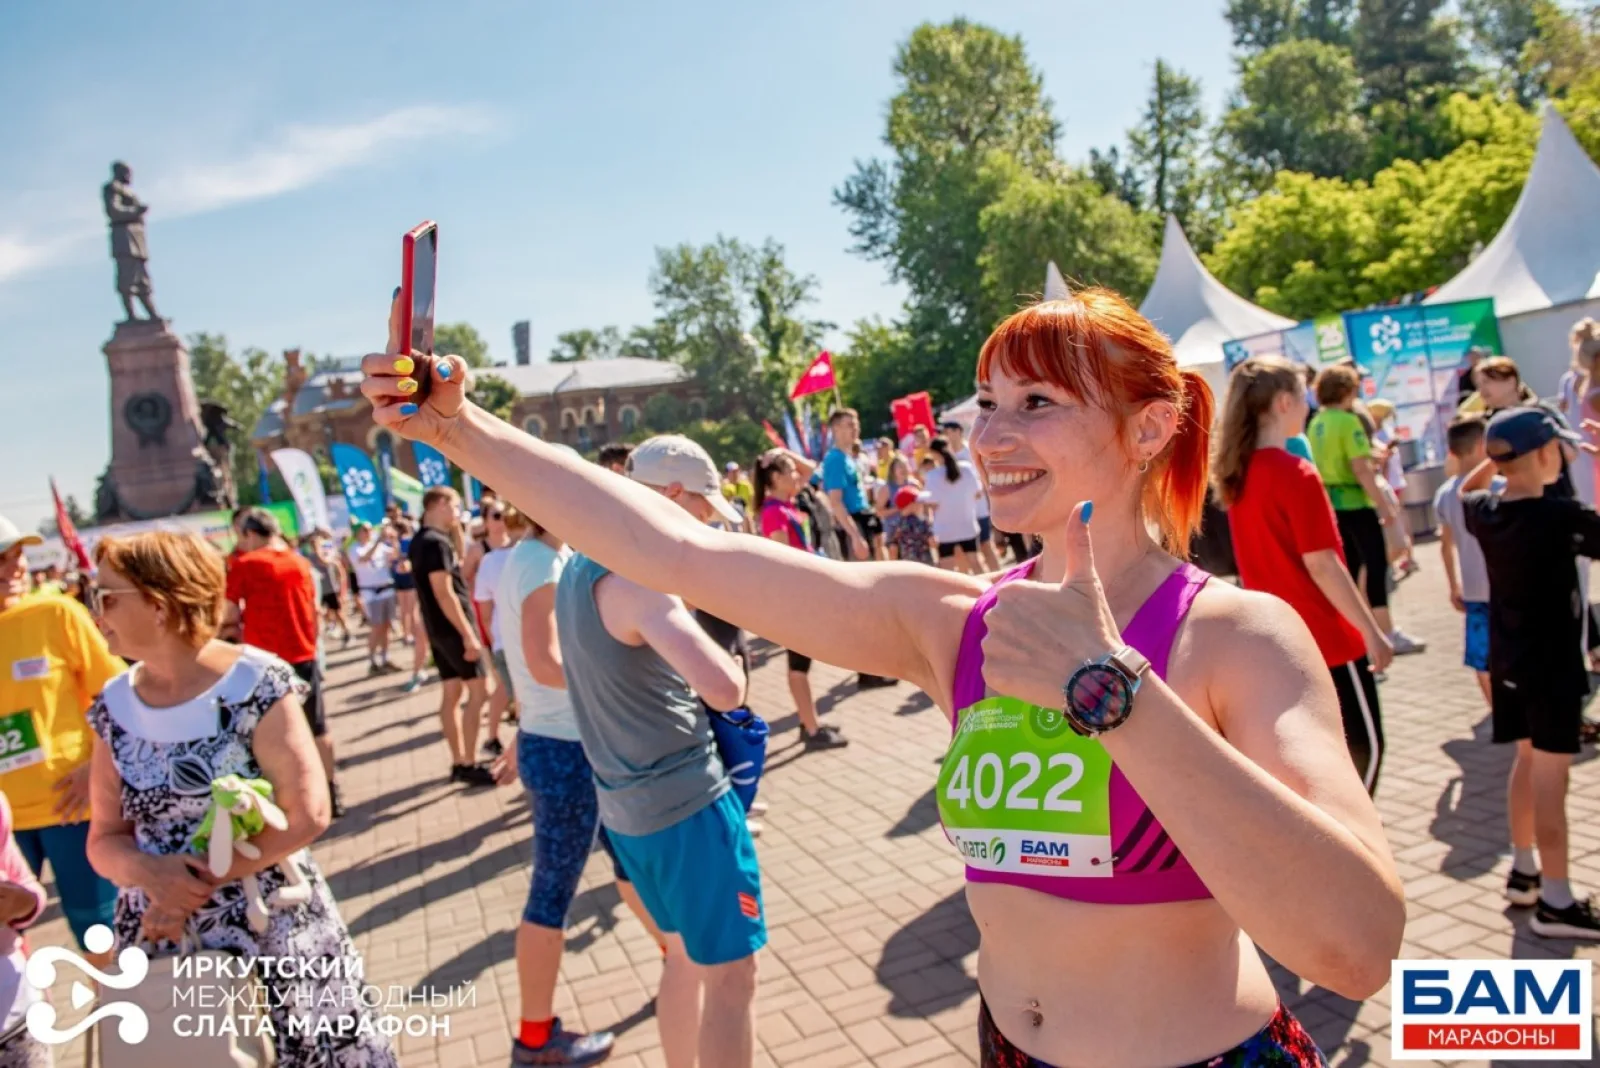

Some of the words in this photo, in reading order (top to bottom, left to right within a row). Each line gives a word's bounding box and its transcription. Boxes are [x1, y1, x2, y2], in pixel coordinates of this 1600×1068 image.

[1046, 712, 1054, 723] 3
[946, 752, 1084, 813] 4022
[1021, 839, 1069, 857] БАМ
